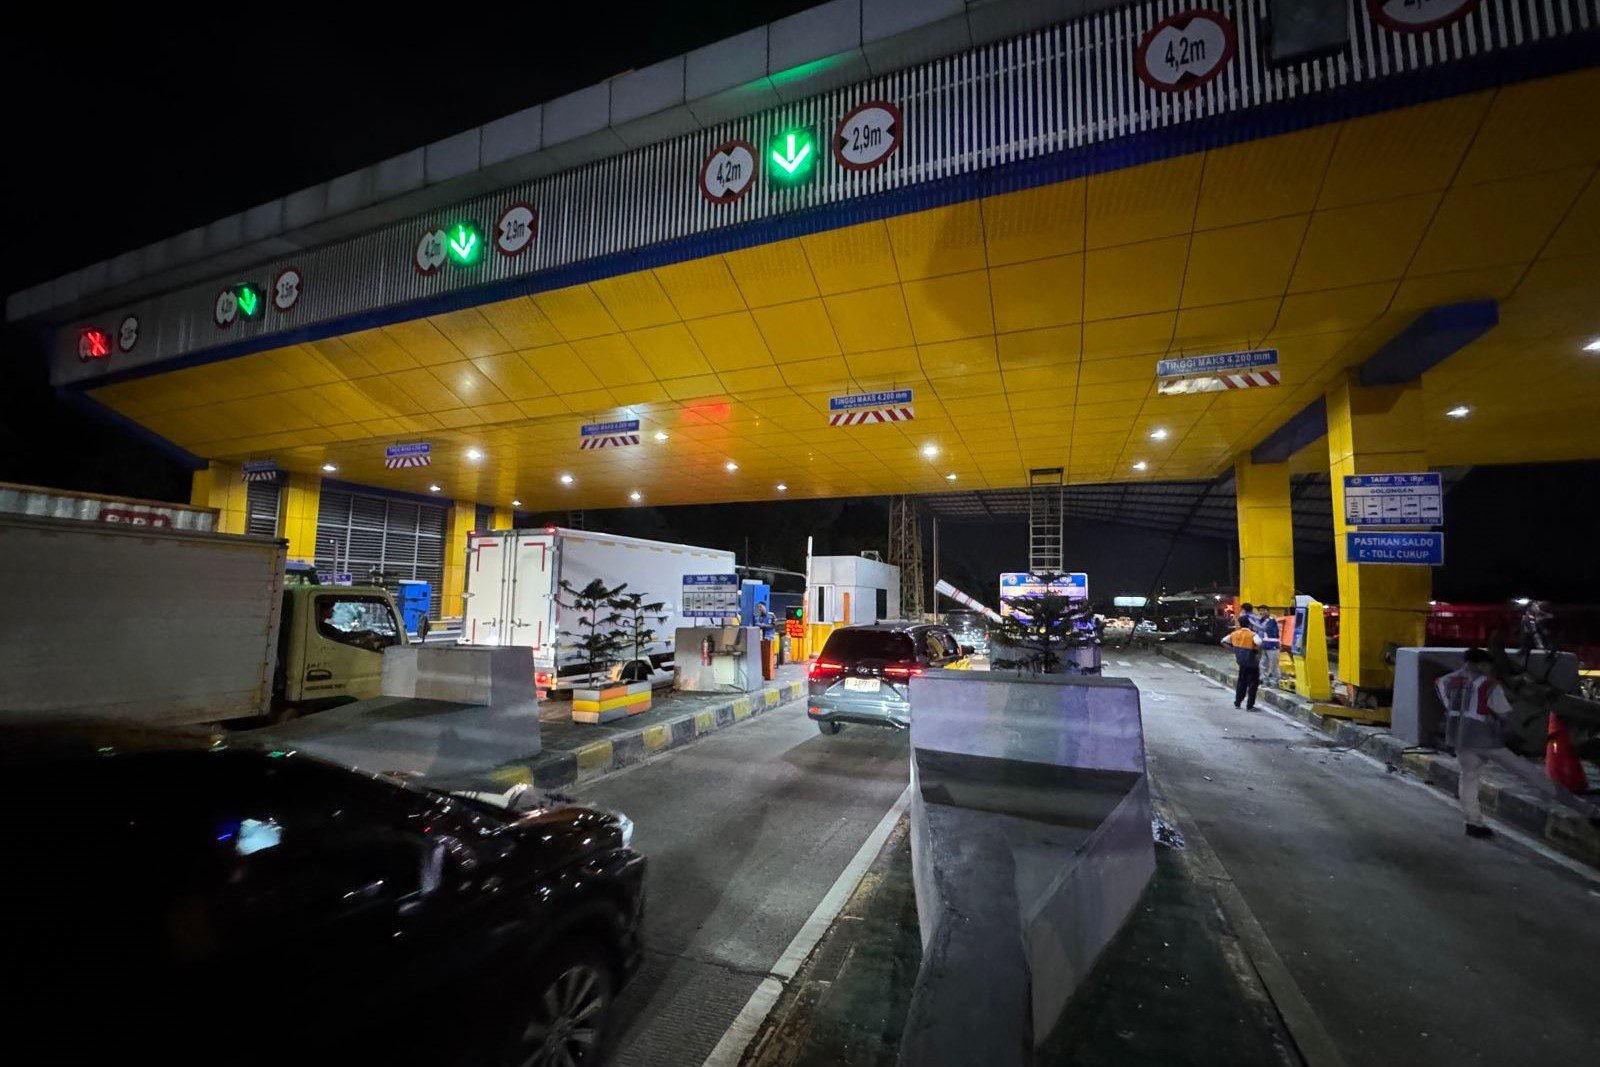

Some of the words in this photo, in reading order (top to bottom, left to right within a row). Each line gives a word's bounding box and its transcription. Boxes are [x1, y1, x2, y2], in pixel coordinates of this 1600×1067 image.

[1165, 37, 1206, 71] 4,2m
[852, 125, 882, 156] 2,9m
[716, 161, 742, 187] 4,2m
[1354, 538, 1401, 546] PASTIKAN
[1402, 538, 1434, 546] SALDO
[1396, 550, 1429, 558] CUKUP
